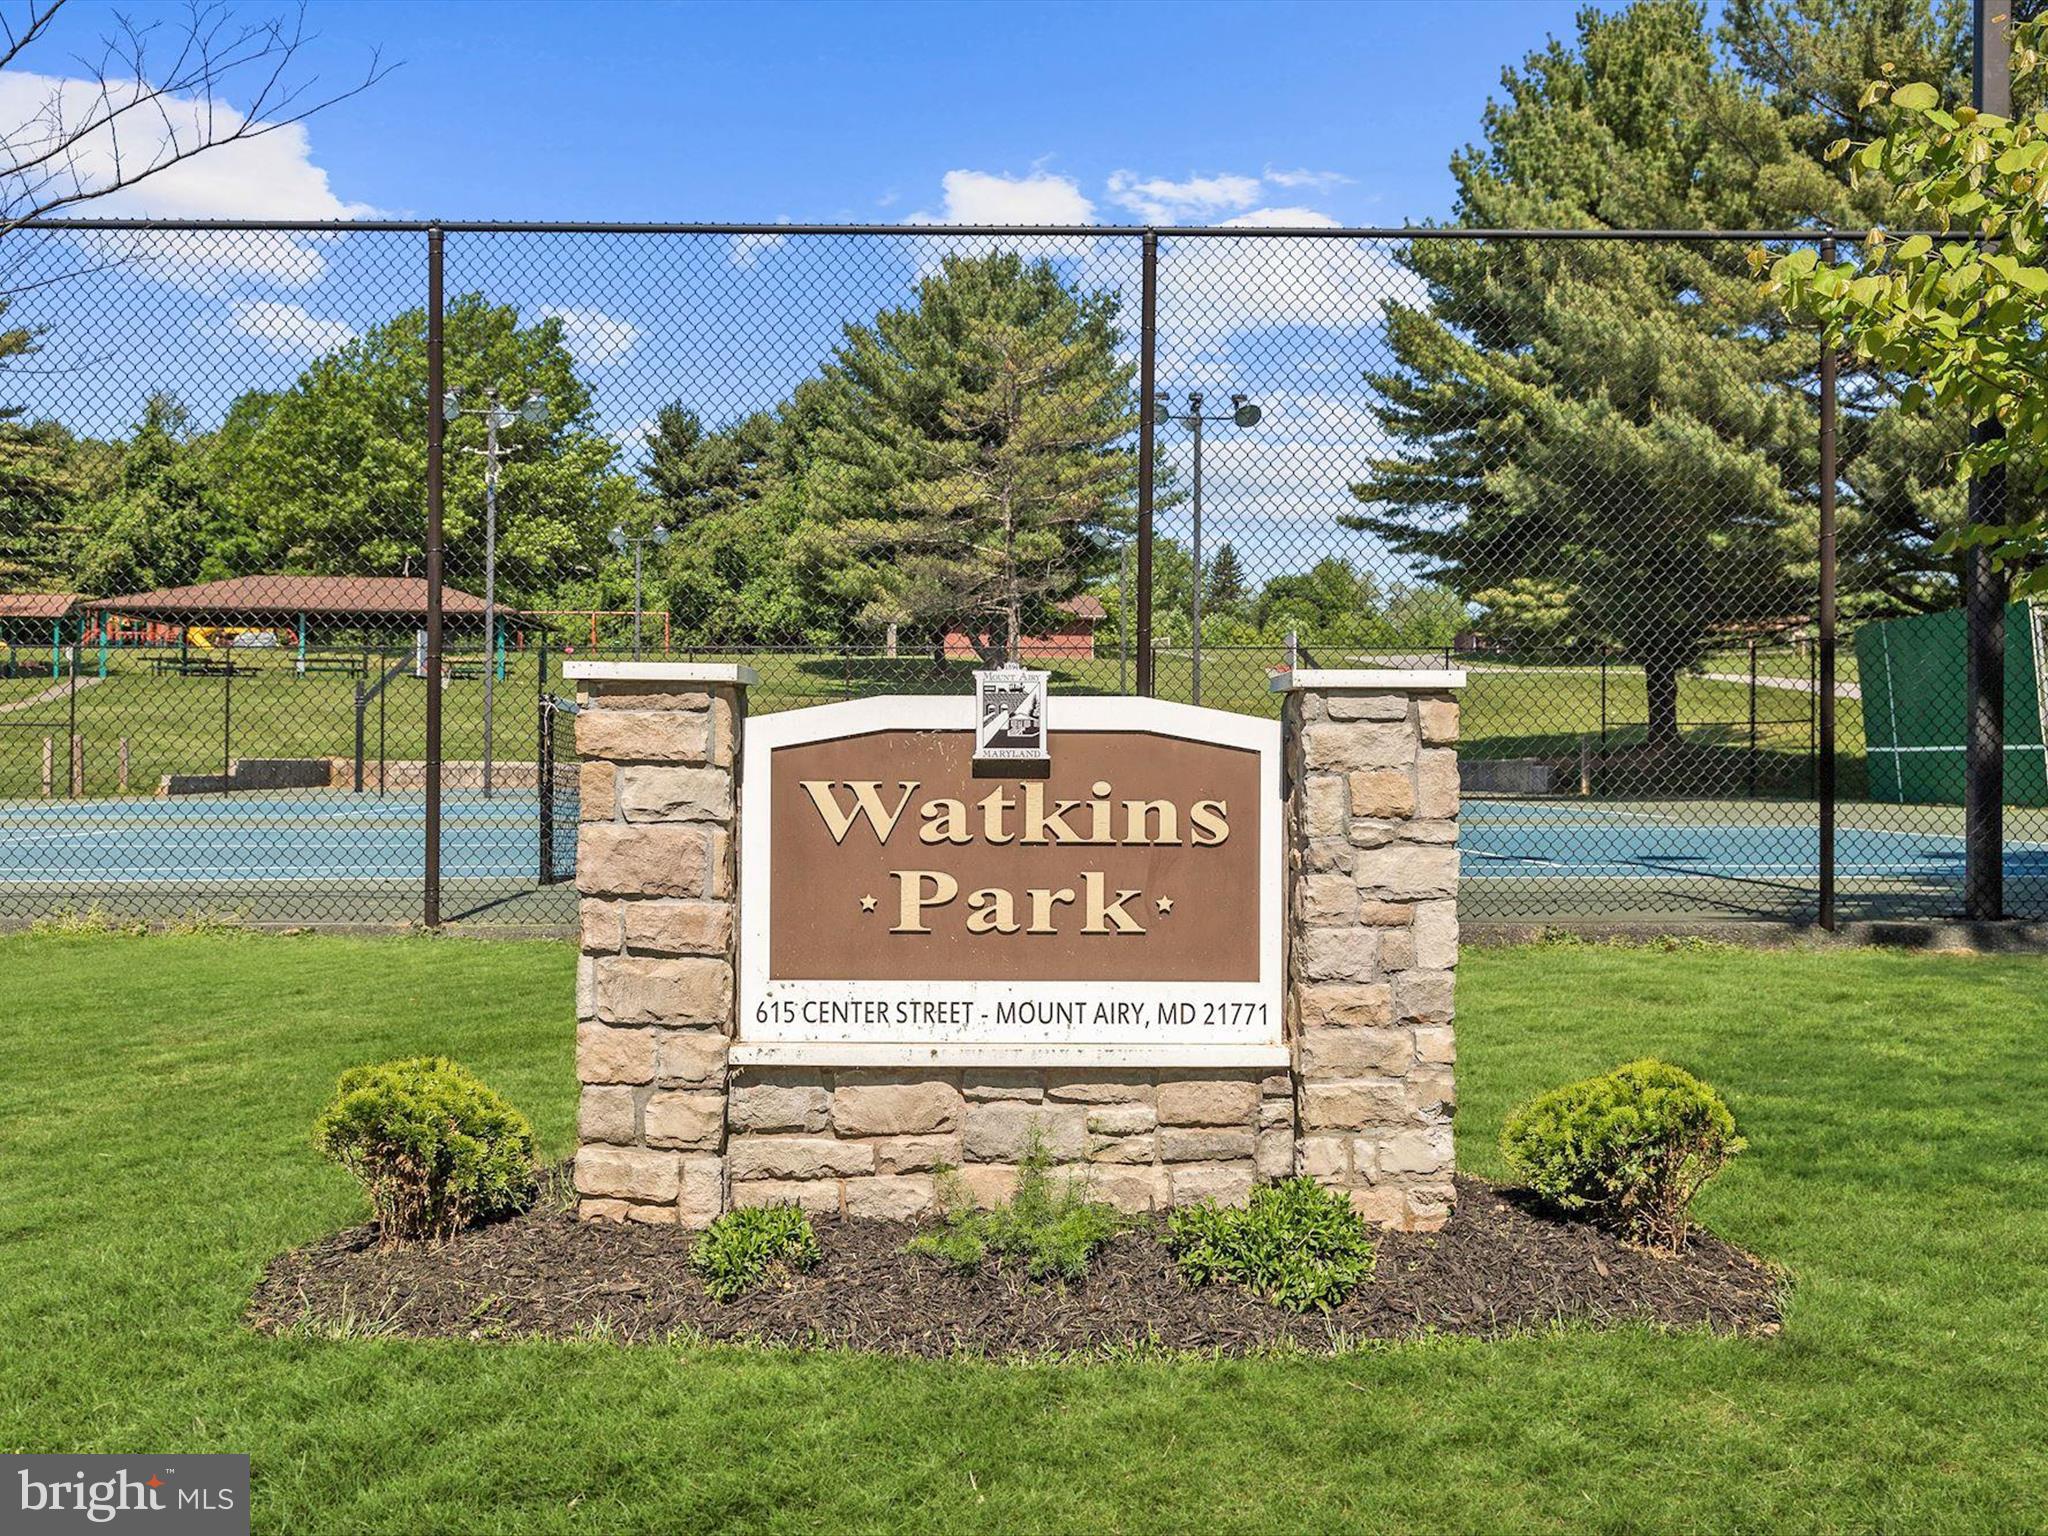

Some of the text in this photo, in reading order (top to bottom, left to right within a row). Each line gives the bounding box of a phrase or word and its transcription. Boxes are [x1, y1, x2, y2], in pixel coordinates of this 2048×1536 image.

[982, 749, 1041, 759] MARYLAND
[800, 780, 1230, 847] Watkins
[889, 869, 1147, 936] Park
[756, 1001, 796, 1024] 615
[802, 1001, 889, 1024] CENTER
[896, 1001, 974, 1024] STREET
[996, 1001, 1087, 1025] MOUNT
[1093, 1002, 1151, 1029] AIRY,
[1157, 1002, 1197, 1025] MD
[1203, 1002, 1268, 1026] 21771
